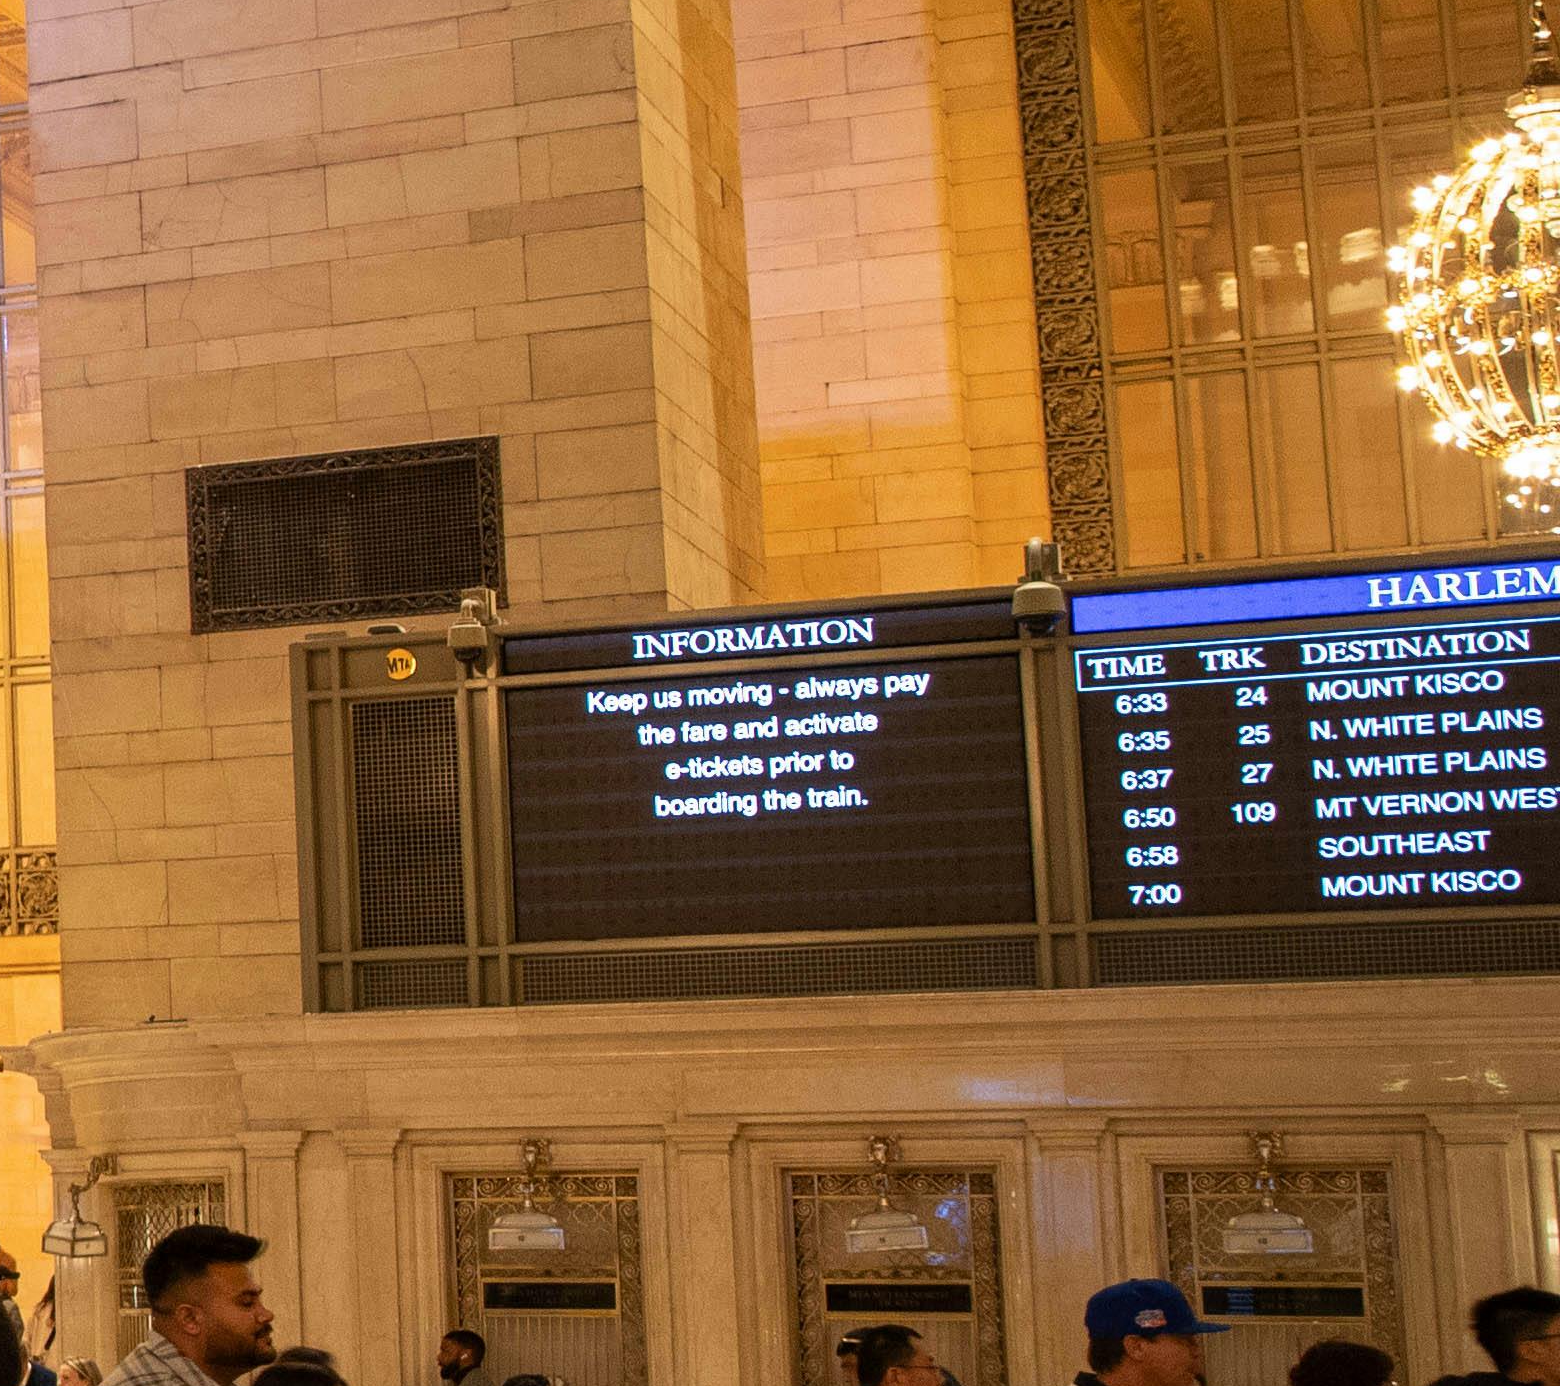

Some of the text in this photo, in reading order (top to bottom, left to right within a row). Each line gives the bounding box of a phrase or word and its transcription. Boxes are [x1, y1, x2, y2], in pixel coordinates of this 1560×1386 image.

[632, 618, 874, 659] INFORMATION
[1087, 629, 1530, 679] TIME TRK DESTINATION
[387, 657, 411, 674] MTA
[587, 691, 648, 715] Keep
[653, 690, 682, 709] us
[688, 681, 773, 707] moving
[794, 676, 879, 700] always
[884, 673, 930, 698] pay
[1116, 669, 1505, 715] 6:33 24 MOUNT KISCO
[638, 712, 879, 746] the fare and activate
[1118, 707, 1544, 752] 6:35 25 N. WHITE PLAINS
[665, 749, 854, 780] e-tickets prior to
[1121, 747, 1547, 791] 6:37 27 N. WHITE PLAINS
[654, 785, 869, 817] boarding the train.
[1124, 807, 1177, 829] 6:50
[1232, 802, 1277, 823] 109
[1316, 797, 1357, 819] MT
[1362, 790, 1484, 816] VERNON
[1127, 830, 1491, 867] 6:58 SOUTHEAST
[1128, 869, 1521, 905] 7:00 MOUNT KISCO
